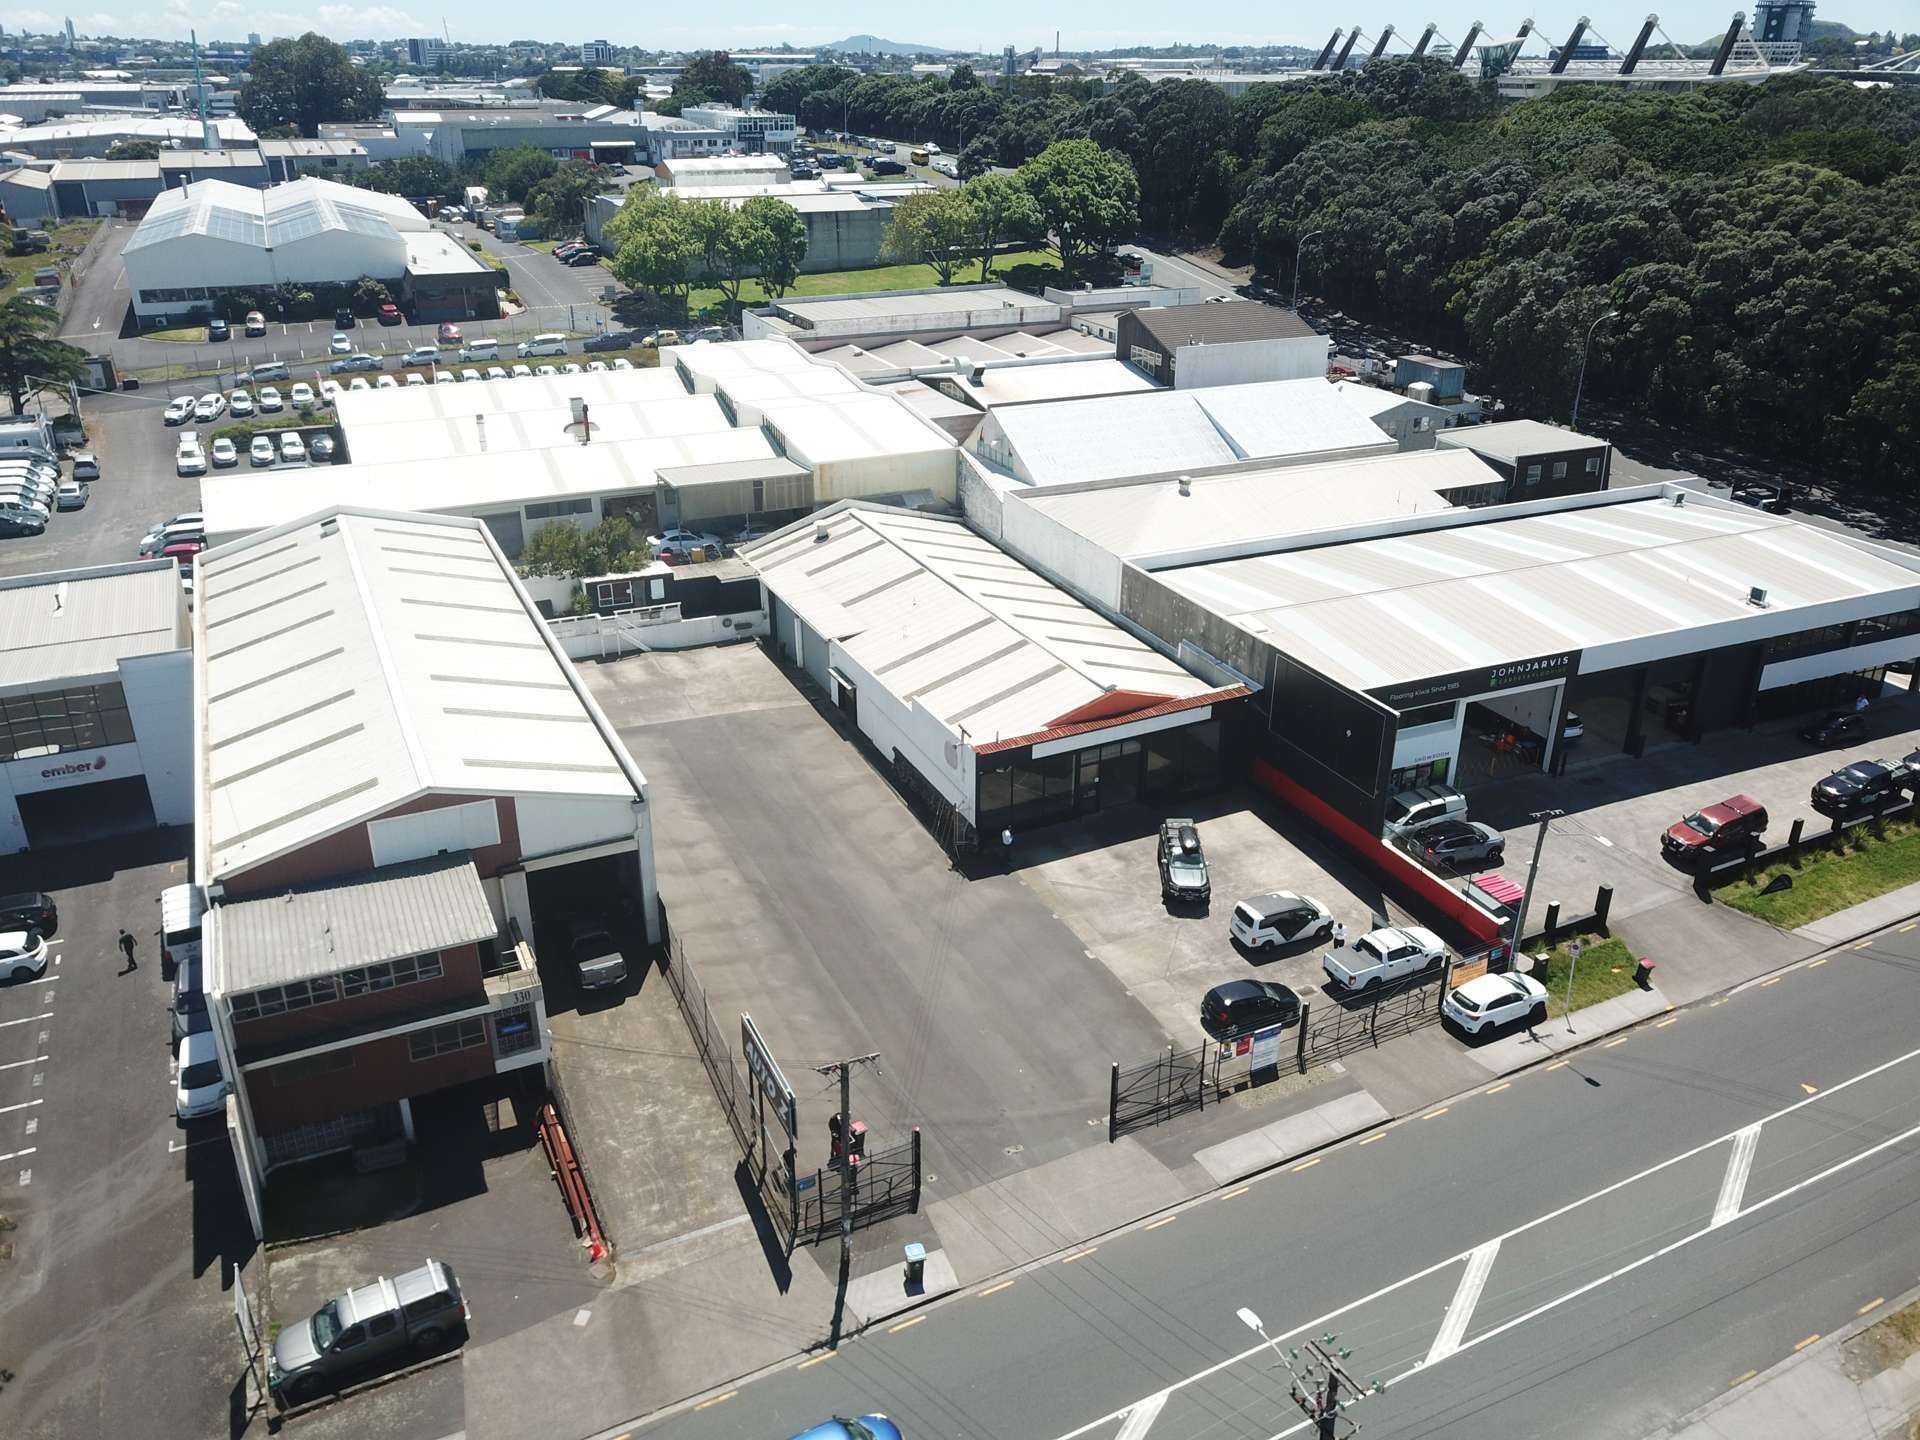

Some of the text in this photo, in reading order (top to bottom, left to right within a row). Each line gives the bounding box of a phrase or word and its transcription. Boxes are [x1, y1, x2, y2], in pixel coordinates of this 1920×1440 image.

[41, 762, 92, 778] ember
[513, 990, 531, 1005] 330
[745, 1041, 776, 1099] AUTO
